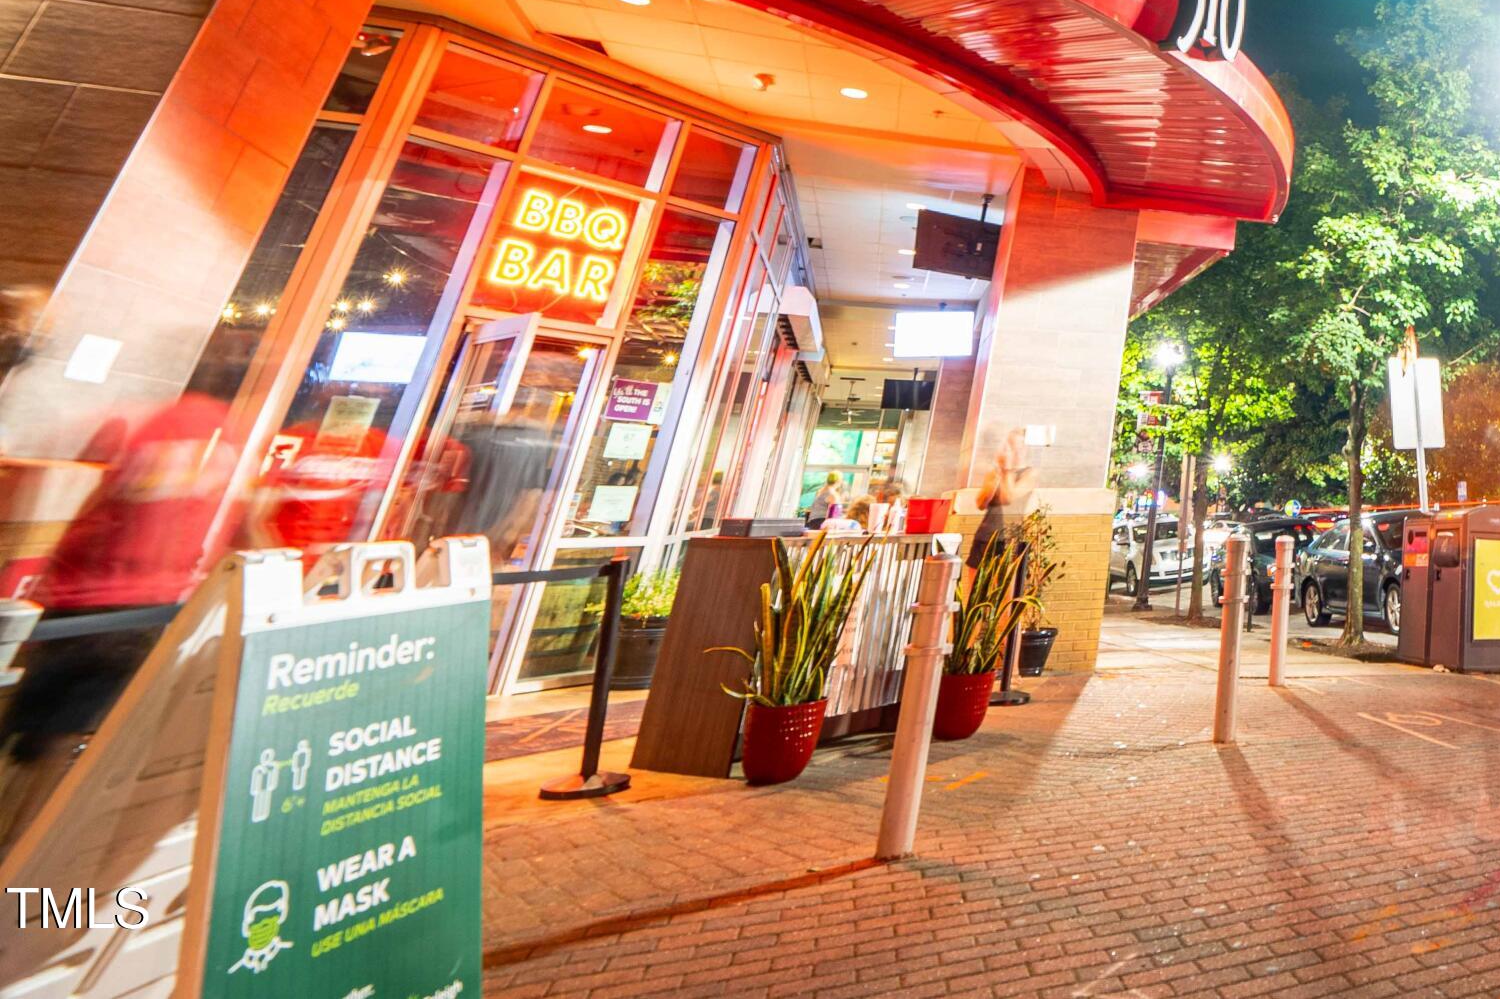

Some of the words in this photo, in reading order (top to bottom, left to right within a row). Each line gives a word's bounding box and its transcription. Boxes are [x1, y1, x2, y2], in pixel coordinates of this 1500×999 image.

[514, 188, 628, 251] BBQ
[489, 238, 614, 303] BAR
[617, 396, 642, 404] SOUTH
[267, 634, 436, 690] Reminder:
[262, 680, 360, 716] Recuerde
[328, 715, 417, 757] SOCIAL
[325, 738, 442, 792] DISTANCE
[320, 800, 395, 836] DISTANCIA
[396, 784, 443, 811] SOCIAL
[322, 780, 401, 816] MANTENGA
[401, 774, 420, 791] LA
[317, 843, 396, 892] WEAR
[397, 835, 417, 862] A
[313, 877, 391, 932] MASK
[311, 930, 344, 958] USE
[344, 917, 377, 942] UNA
